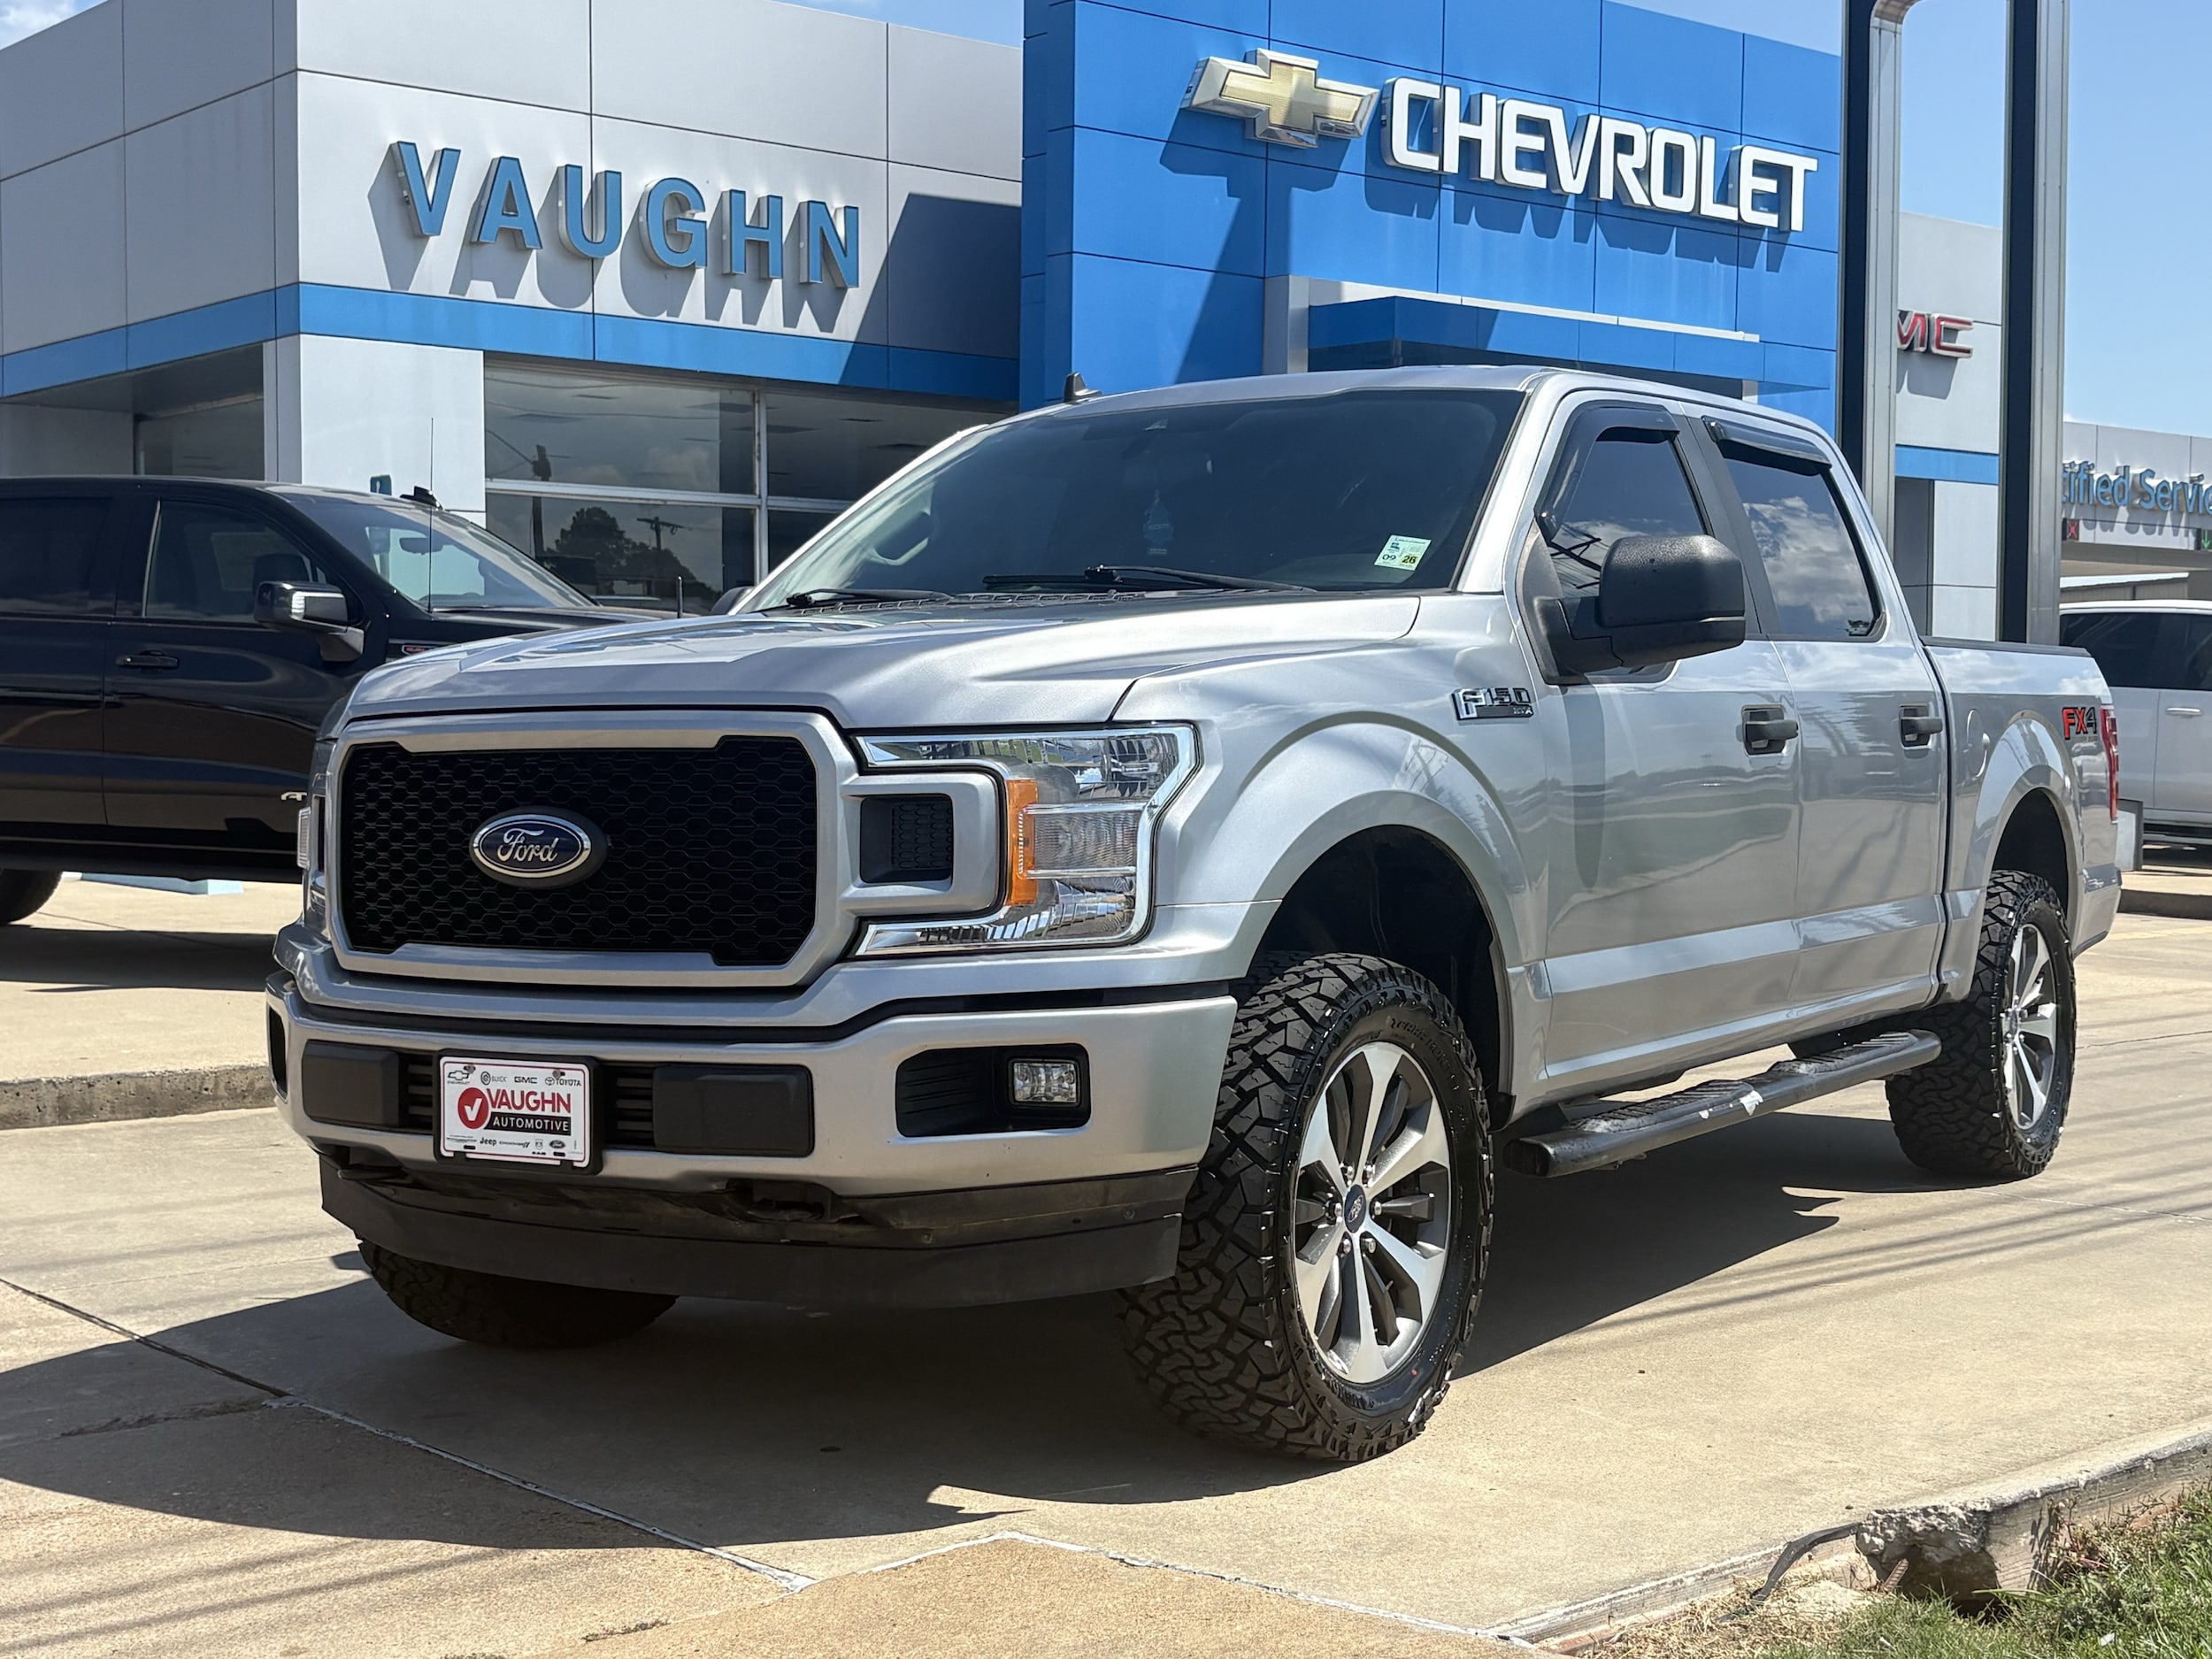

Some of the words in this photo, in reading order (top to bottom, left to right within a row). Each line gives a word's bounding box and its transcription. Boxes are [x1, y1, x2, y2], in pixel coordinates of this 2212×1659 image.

[1383, 77, 1818, 232] CHEVROLET
[390, 141, 859, 288] VAUGHN
[1402, 555, 1417, 565] 26
[2062, 706, 2097, 740] FX4
[497, 827, 559, 862] Ford
[486, 1087, 572, 1113] VAUGHN
[493, 1116, 569, 1132] AUTOMOTIVE
[480, 1137, 497, 1147] Jeep
